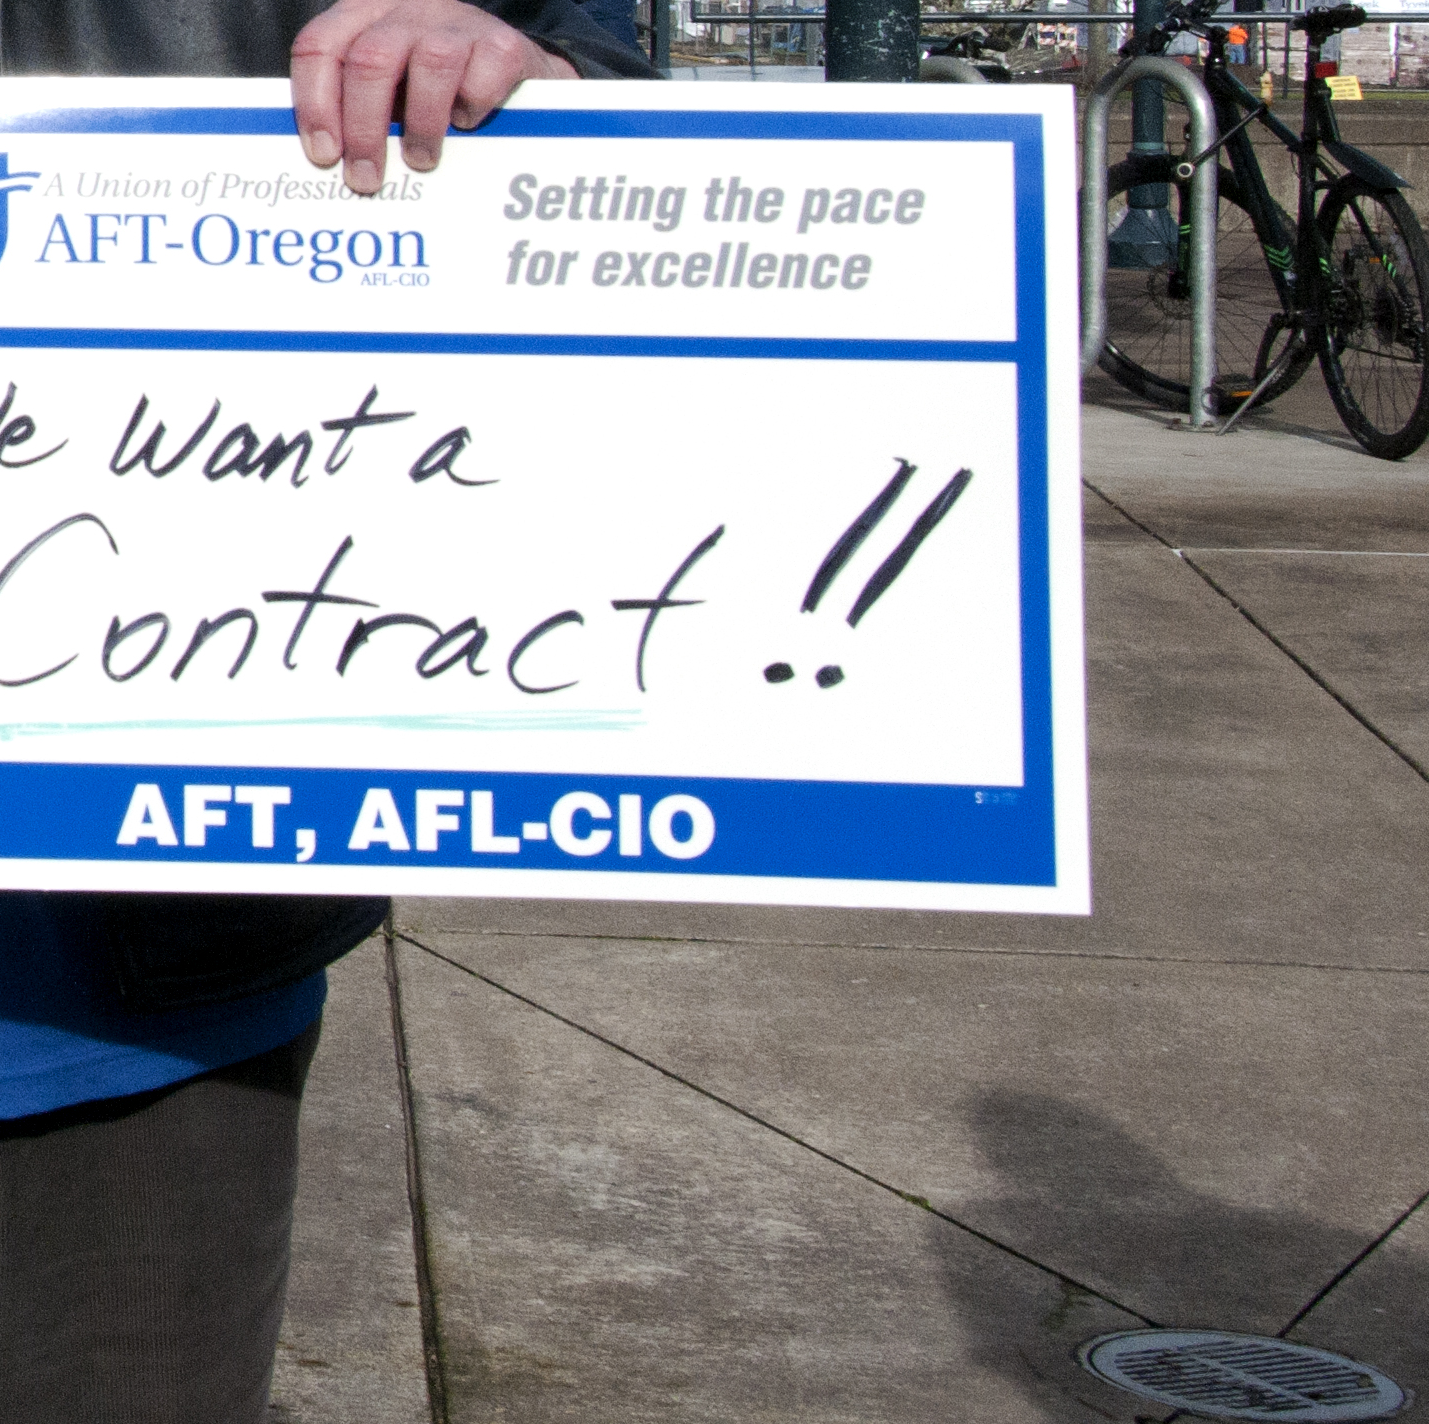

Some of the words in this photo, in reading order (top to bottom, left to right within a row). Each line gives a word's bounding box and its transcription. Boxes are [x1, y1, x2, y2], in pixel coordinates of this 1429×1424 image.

[42, 172, 65, 198] A
[76, 172, 171, 199] Union
[181, 171, 217, 206] of
[218, 171, 425, 207] Professioals
[503, 173, 687, 233] Setting
[703, 177, 785, 225] the
[797, 184, 926, 235] pace
[34, 213, 431, 284] AFT-Oregon
[360, 272, 431, 287] AFL-CIO
[505, 240, 579, 287] for
[592, 241, 873, 291] excellence
[108, 382, 417, 490] Want
[408, 425, 501, 488] a
[115, 782, 318, 864] AFT,
[346, 788, 717, 861] AFL-CIO
